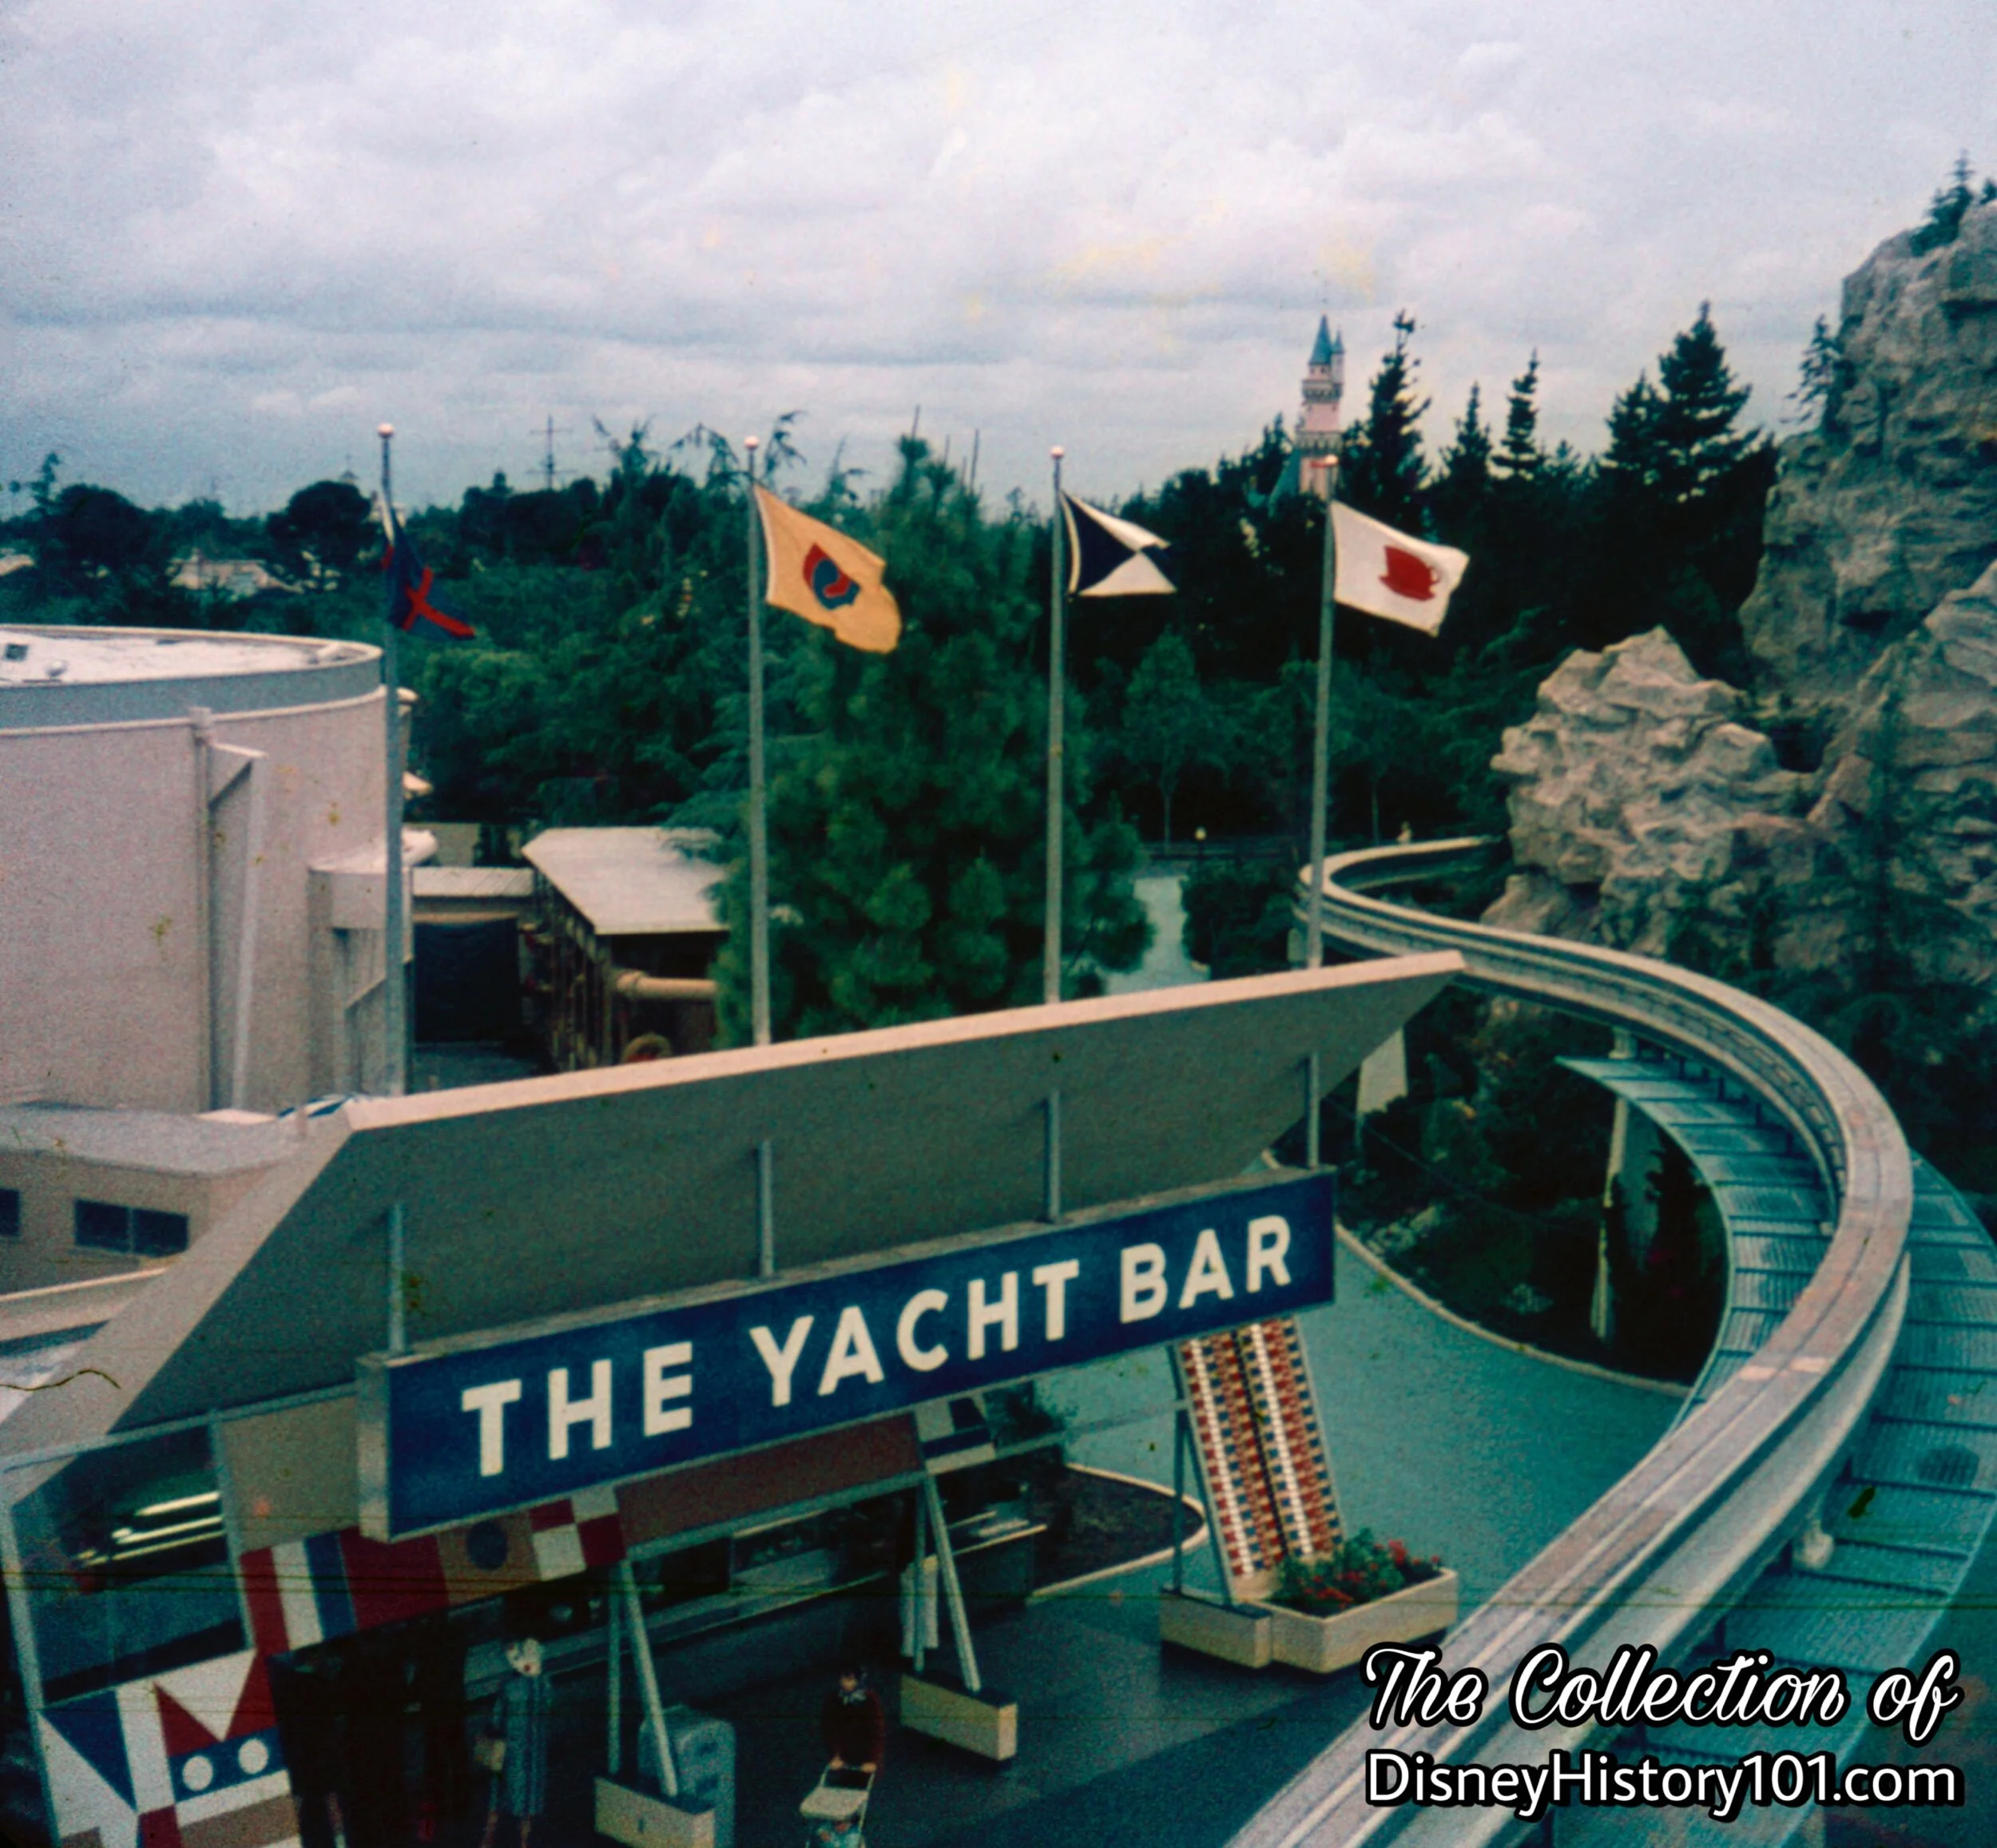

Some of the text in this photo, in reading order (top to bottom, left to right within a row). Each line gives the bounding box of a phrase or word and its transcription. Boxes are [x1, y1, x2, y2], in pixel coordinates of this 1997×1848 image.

[463, 1217, 1289, 1475] THE YACHT BAR
